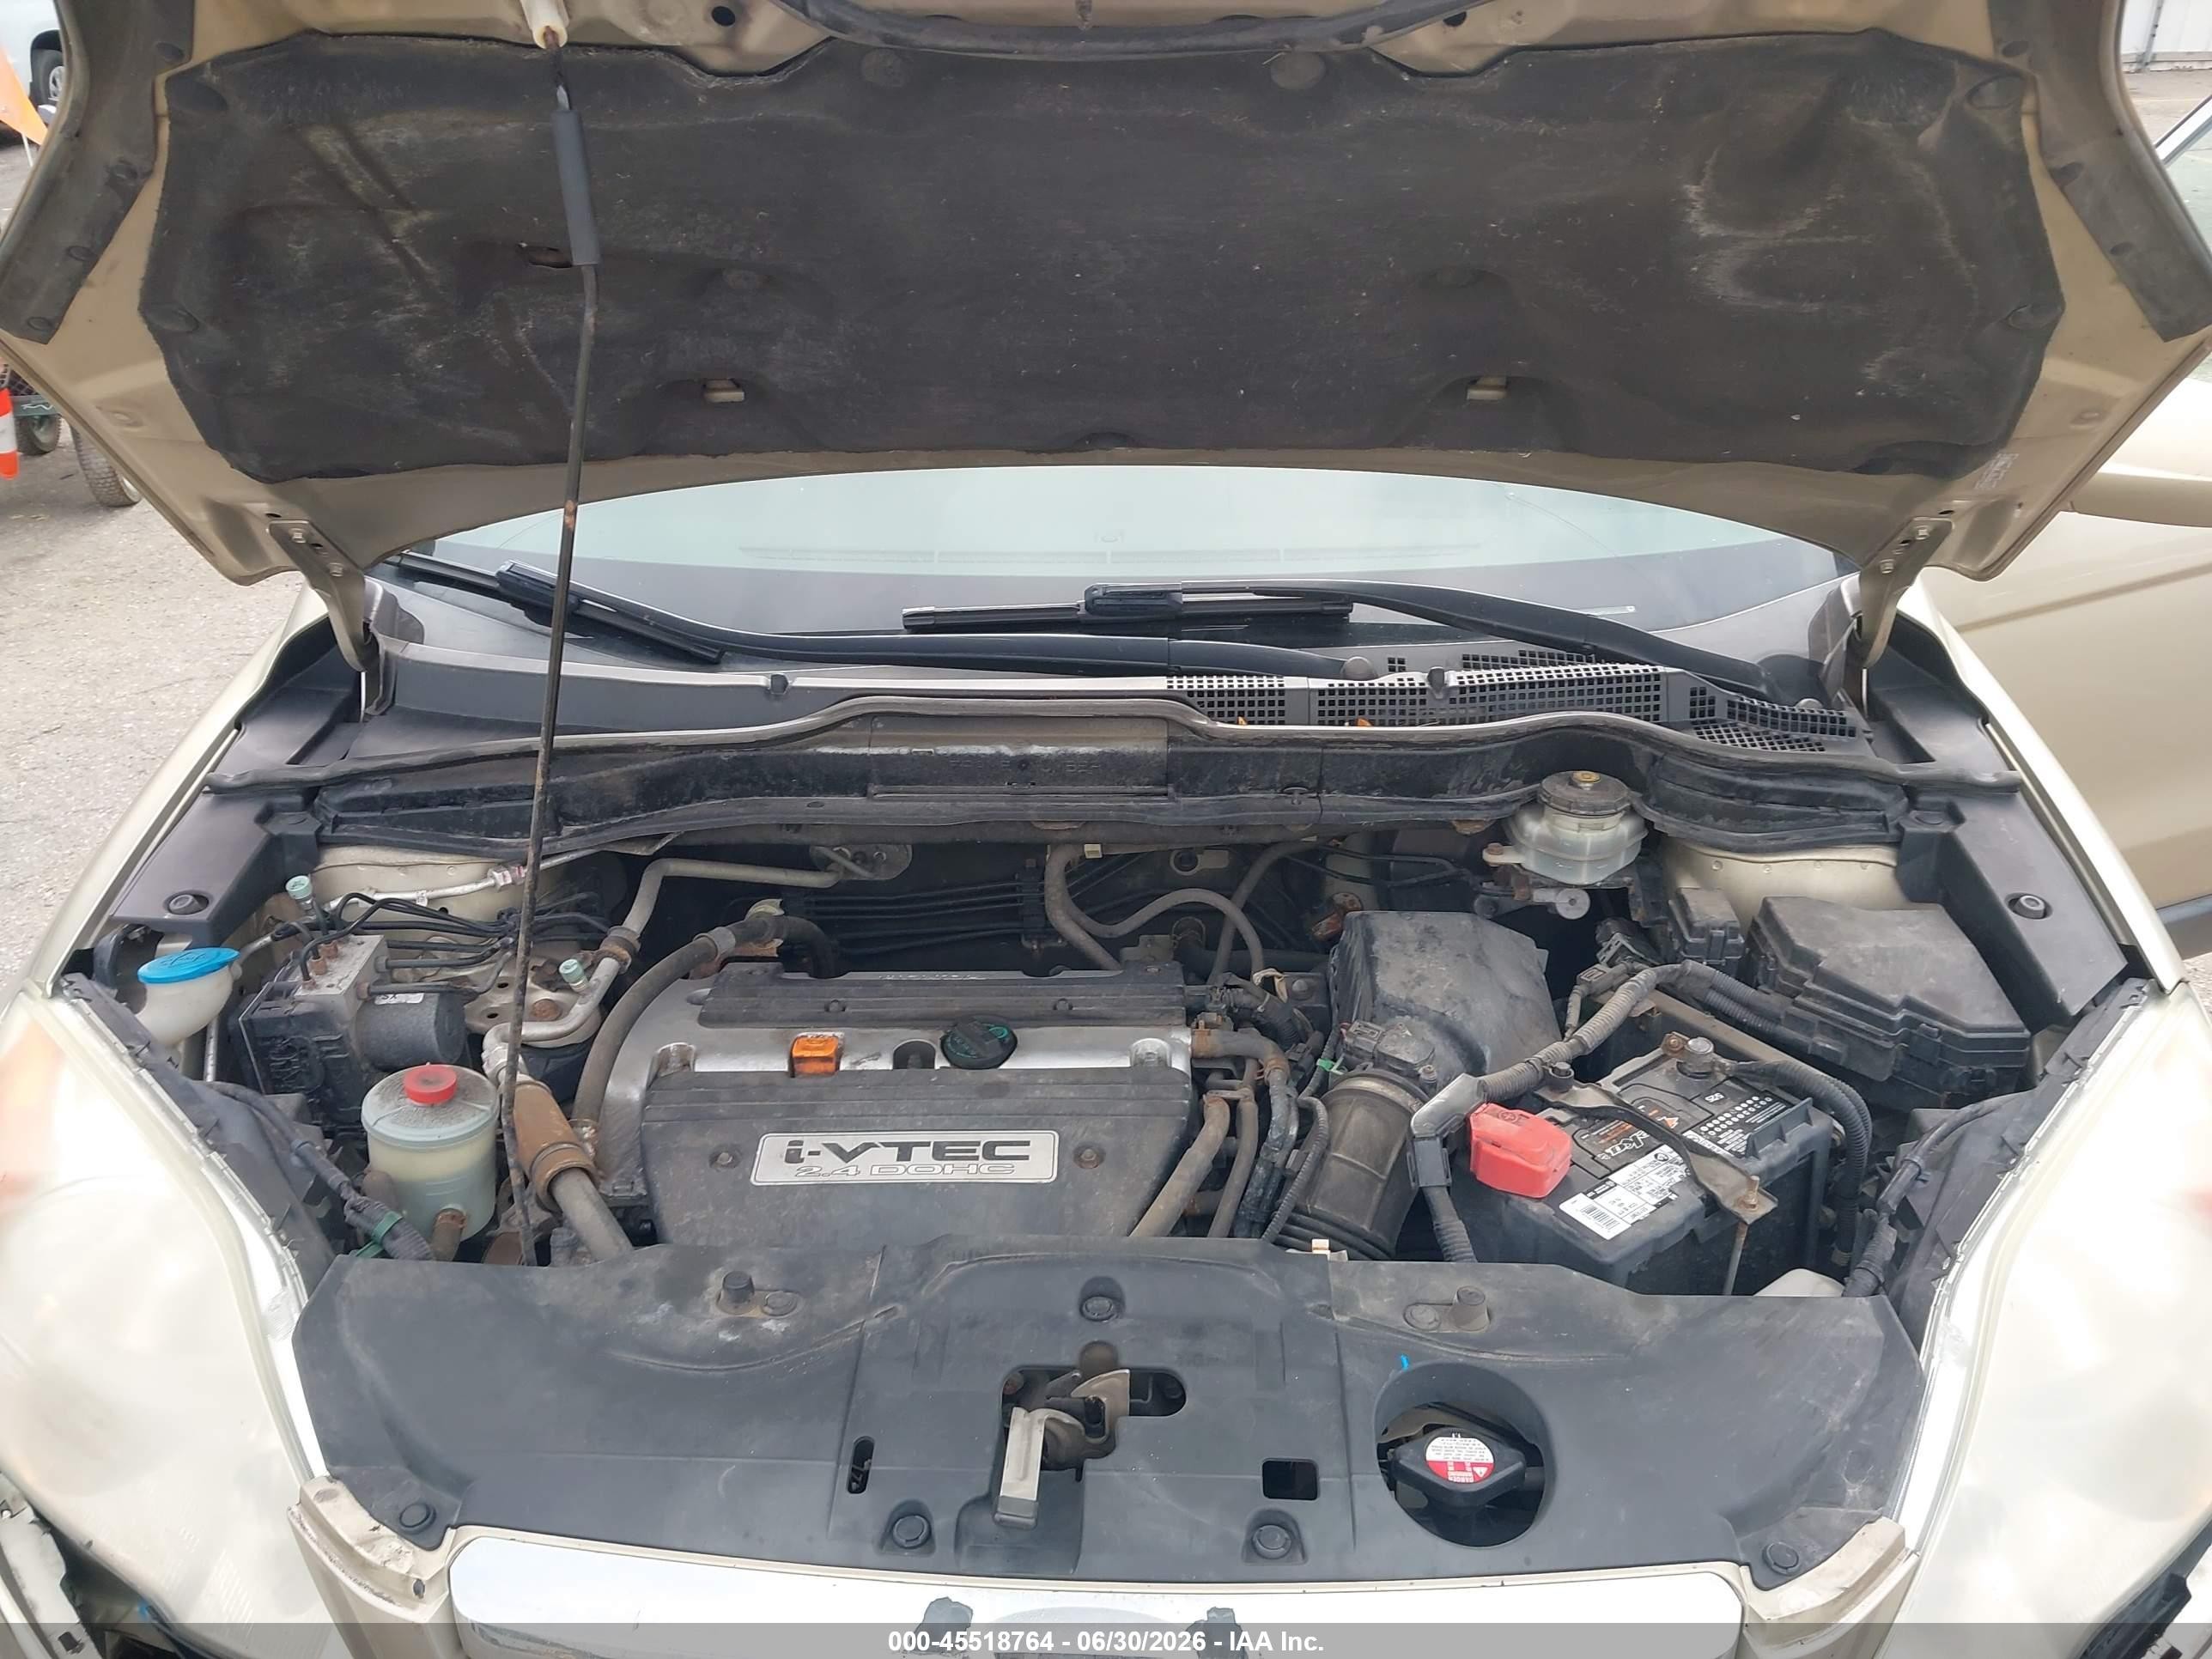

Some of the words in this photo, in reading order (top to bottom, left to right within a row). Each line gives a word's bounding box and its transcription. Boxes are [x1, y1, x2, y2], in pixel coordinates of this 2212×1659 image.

[784, 1139, 1031, 1164] i-VTEC
[795, 1164, 861, 1177] 2.4
[870, 1163, 1016, 1176] DOHC
